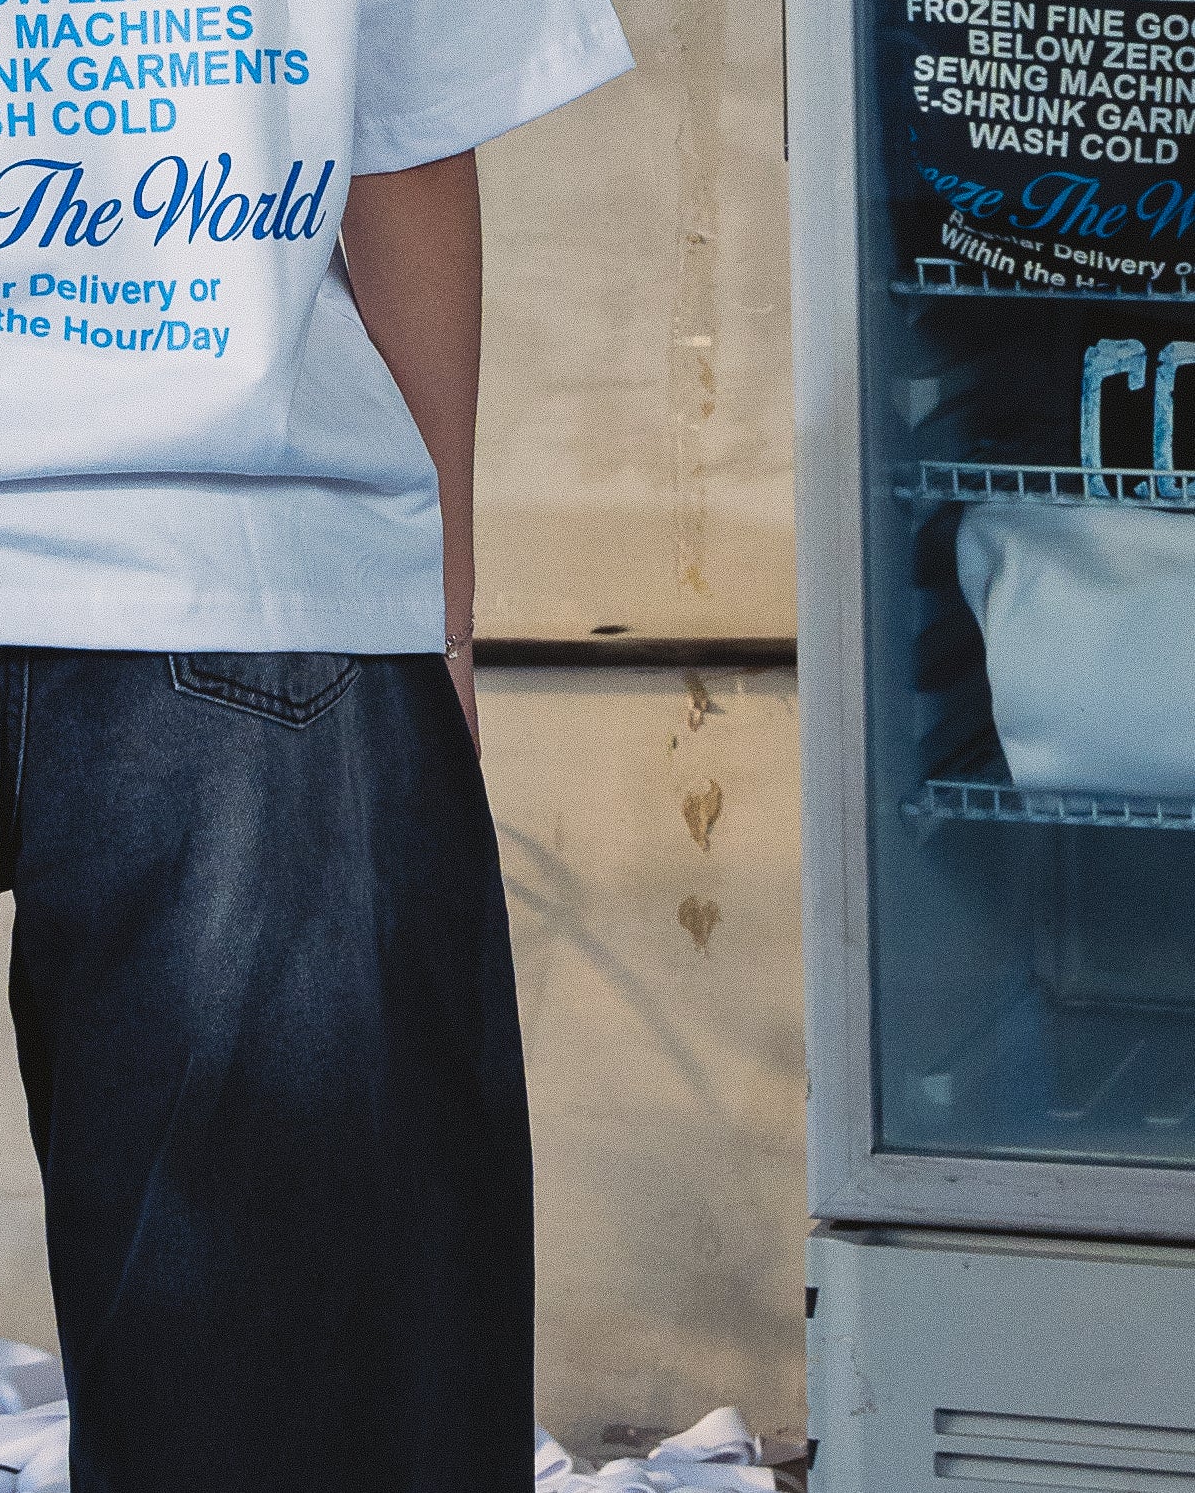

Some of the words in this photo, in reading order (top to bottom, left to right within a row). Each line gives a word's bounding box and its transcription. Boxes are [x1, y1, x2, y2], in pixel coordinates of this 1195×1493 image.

[14, 4, 255, 51] MACHINES
[1046, 5, 1125, 38] FINE
[65, 47, 311, 93] GARMENTS
[968, 29, 1095, 65] BELOW
[1103, 41, 1195, 73] ZERO
[913, 55, 1049, 93] SEWING
[51, 97, 177, 137] COLD
[968, 121, 1069, 158] WASH
[1080, 133, 1179, 165] COLD
[133, 152, 336, 247] World
[1009, 170, 1129, 239] The
[941, 223, 1016, 275] Within
[1023, 260, 1066, 287] the
[1054, 243, 1165, 280] Delivery
[28, 272, 177, 313] Delivery
[189, 278, 222, 304] or
[63, 314, 230, 359] Hour/Day
